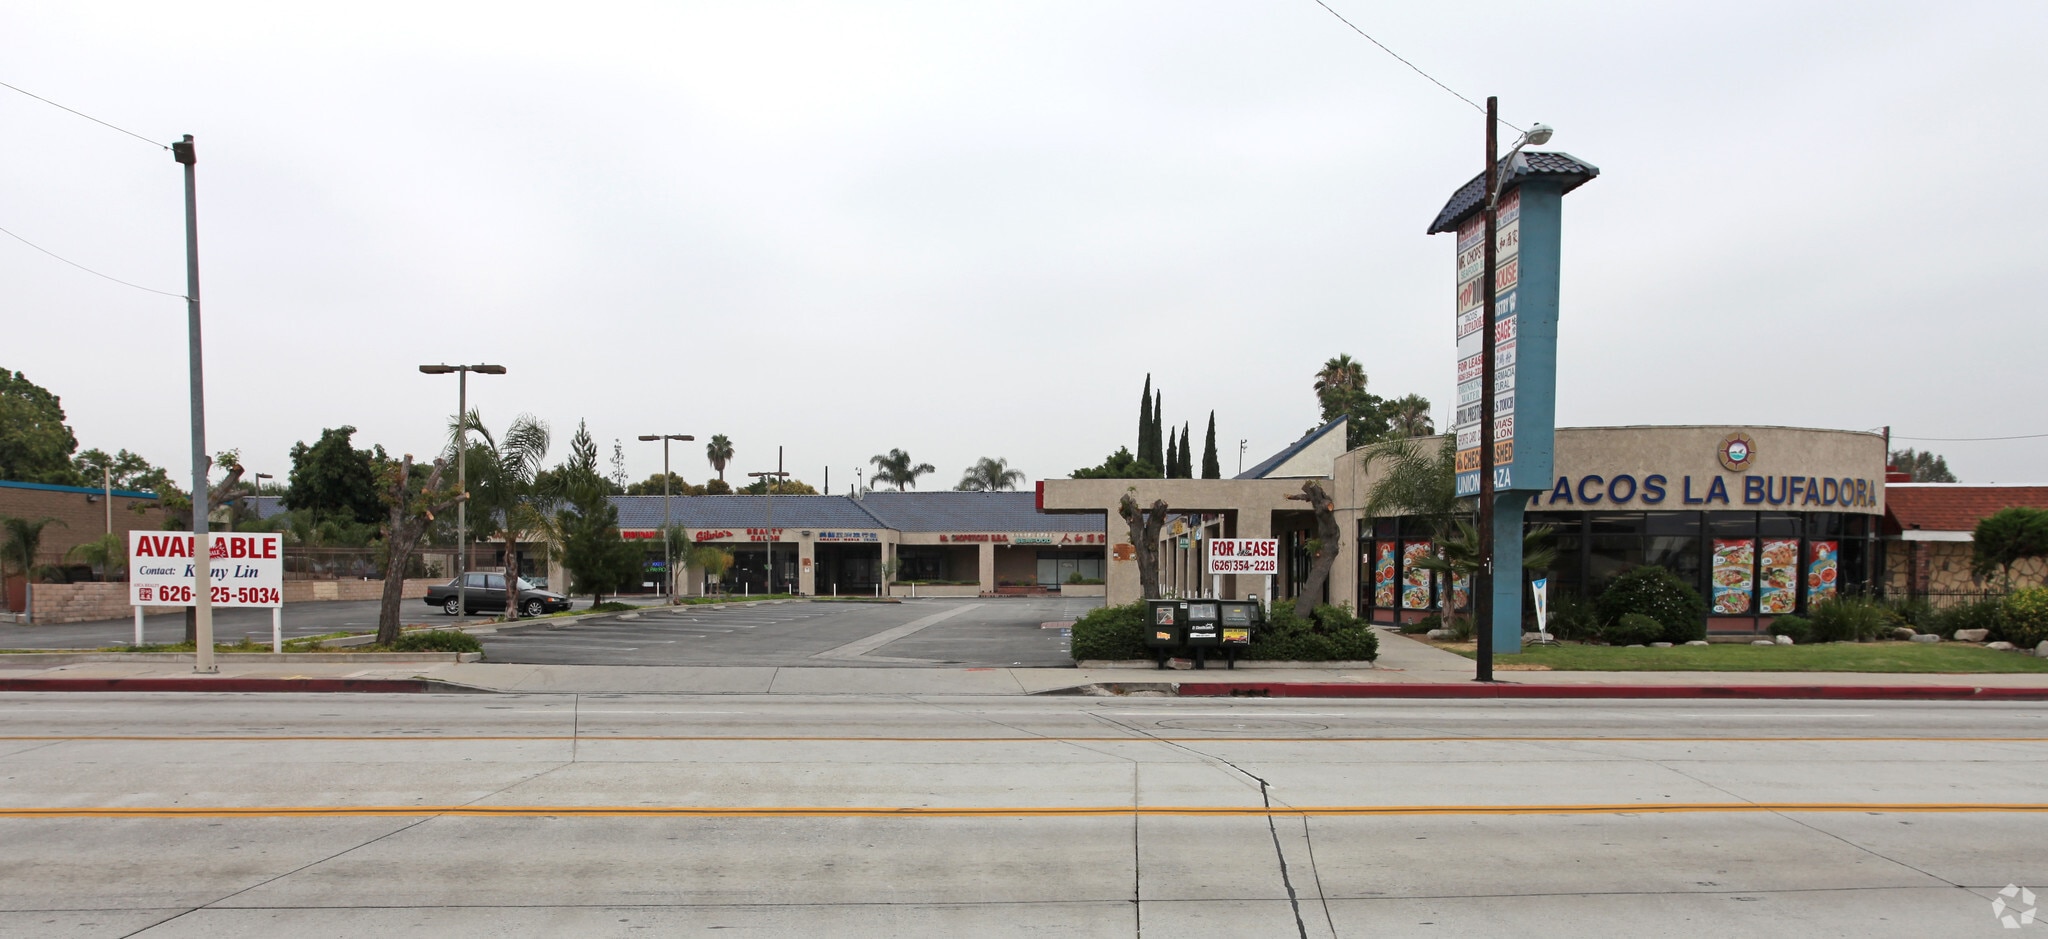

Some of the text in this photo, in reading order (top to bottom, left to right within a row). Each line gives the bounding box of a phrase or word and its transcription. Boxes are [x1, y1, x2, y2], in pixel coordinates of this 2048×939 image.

[1467, 243, 1485, 265] CHOPST
[1458, 360, 1467, 373] FOR
[1461, 389, 1480, 403] WATER
[1499, 396, 1513, 412] TOUCH
[1494, 417, 1513, 429] VIA'S
[1457, 472, 1480, 494] UNION
[1532, 473, 1877, 508] ACOS LA BUFADORA
[136, 535, 277, 559] AVAIABLE
[1212, 541, 1235, 556] FOR
[1238, 541, 1276, 557] LEASE
[139, 564, 259, 581] Contact: Kny Lin
[159, 585, 280, 604] 626-25-5034
